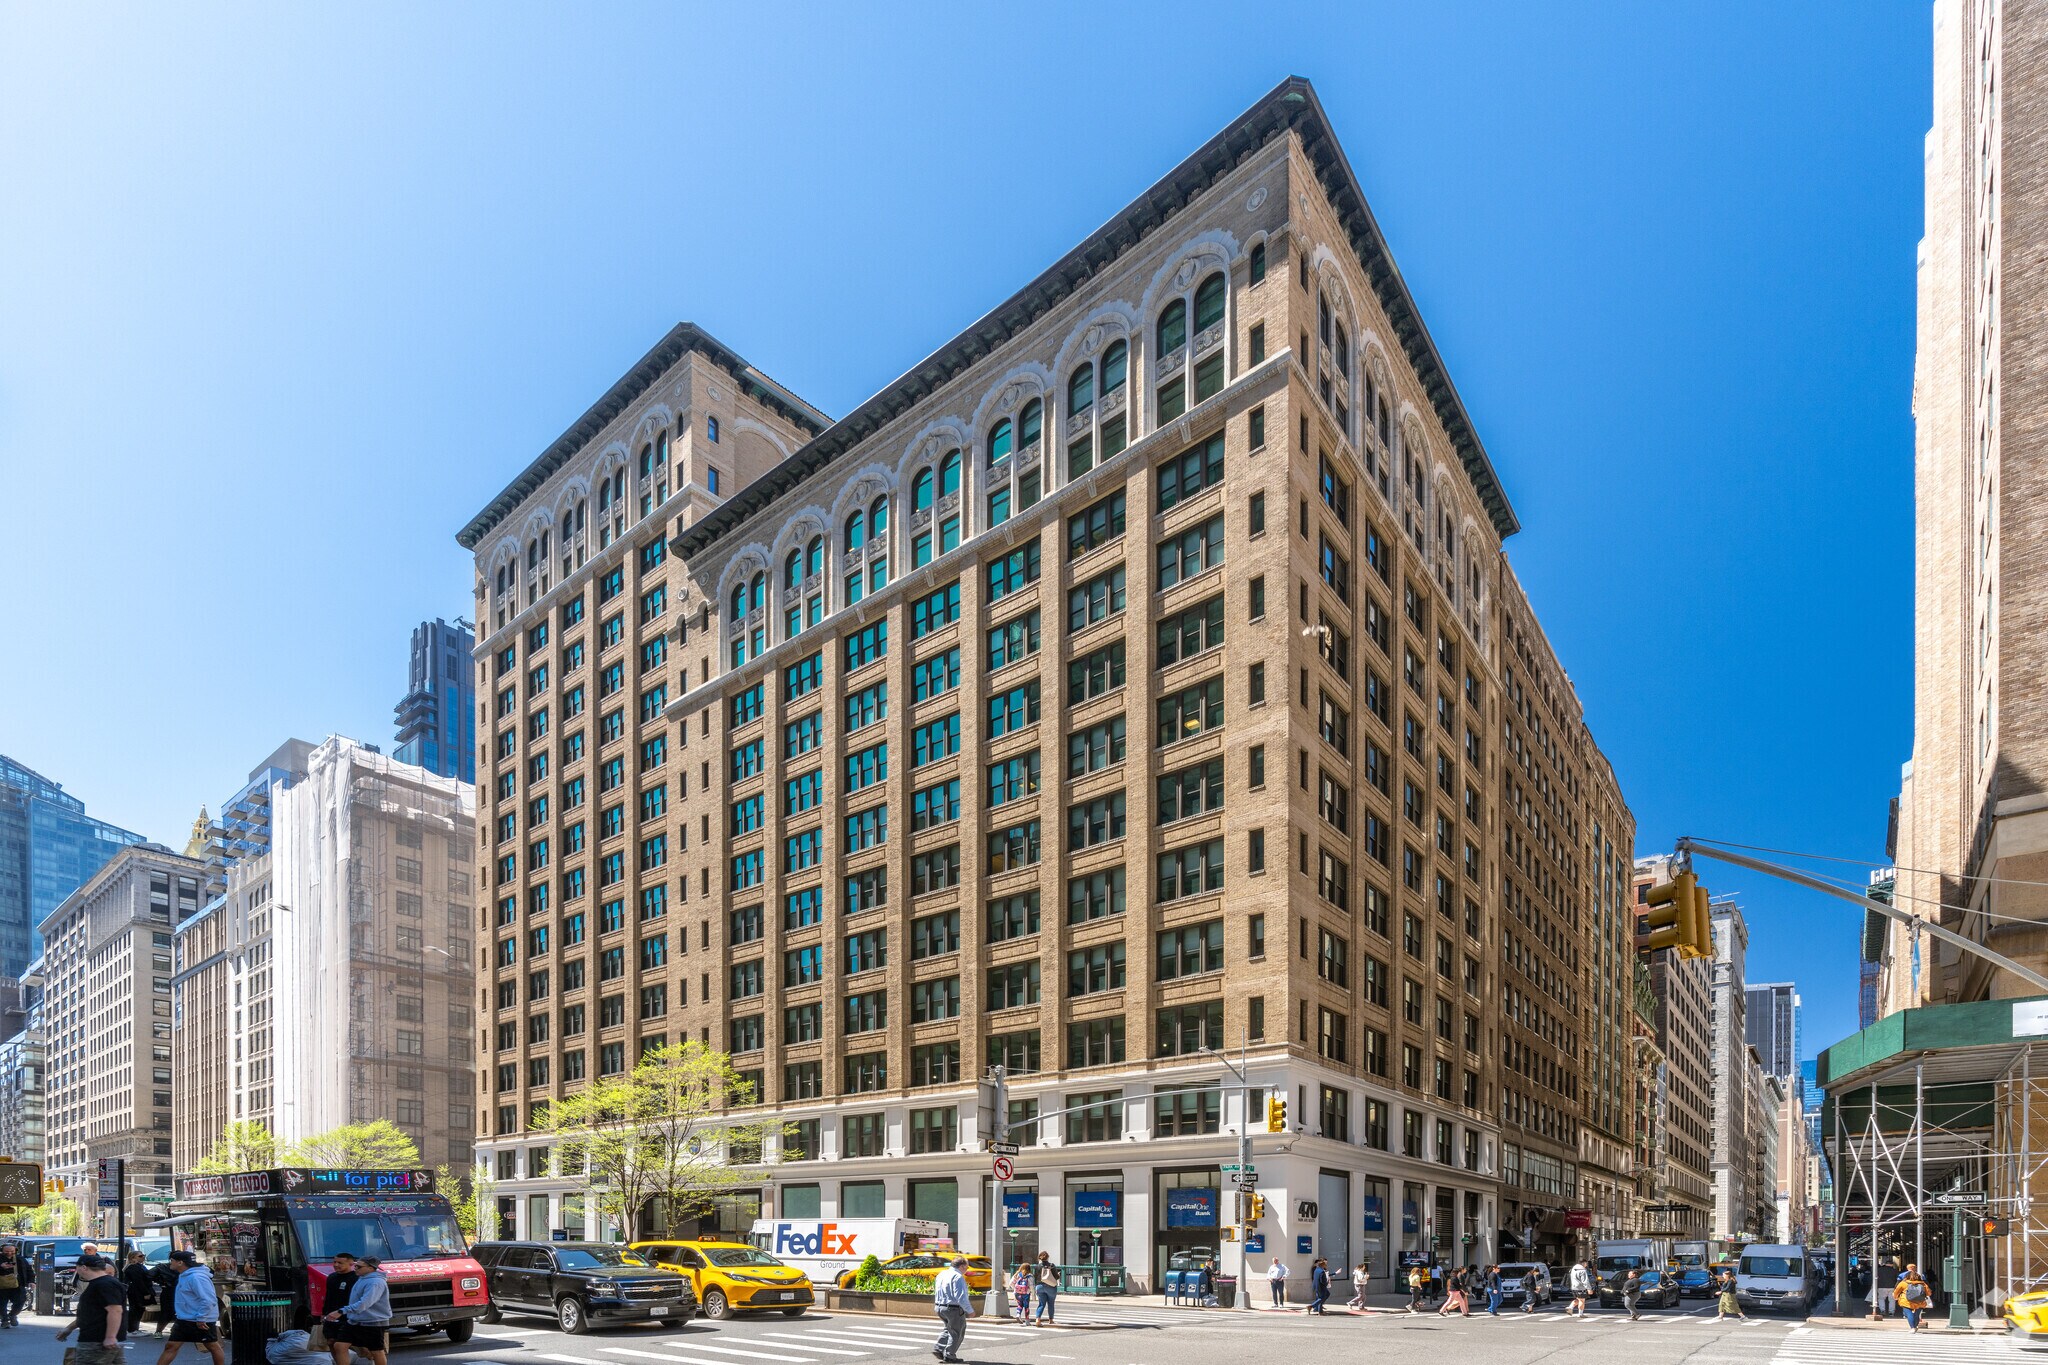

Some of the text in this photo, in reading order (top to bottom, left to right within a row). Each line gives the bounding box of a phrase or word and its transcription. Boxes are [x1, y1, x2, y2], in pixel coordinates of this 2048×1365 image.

[183, 1172, 269, 1198] MEXICO LINDO
[344, 1172, 371, 1185] for
[1298, 1201, 1318, 1218] 470
[776, 1223, 858, 1255] FedEx
[44, 1252, 52, 1260] P
[820, 1260, 846, 1269] Ground
